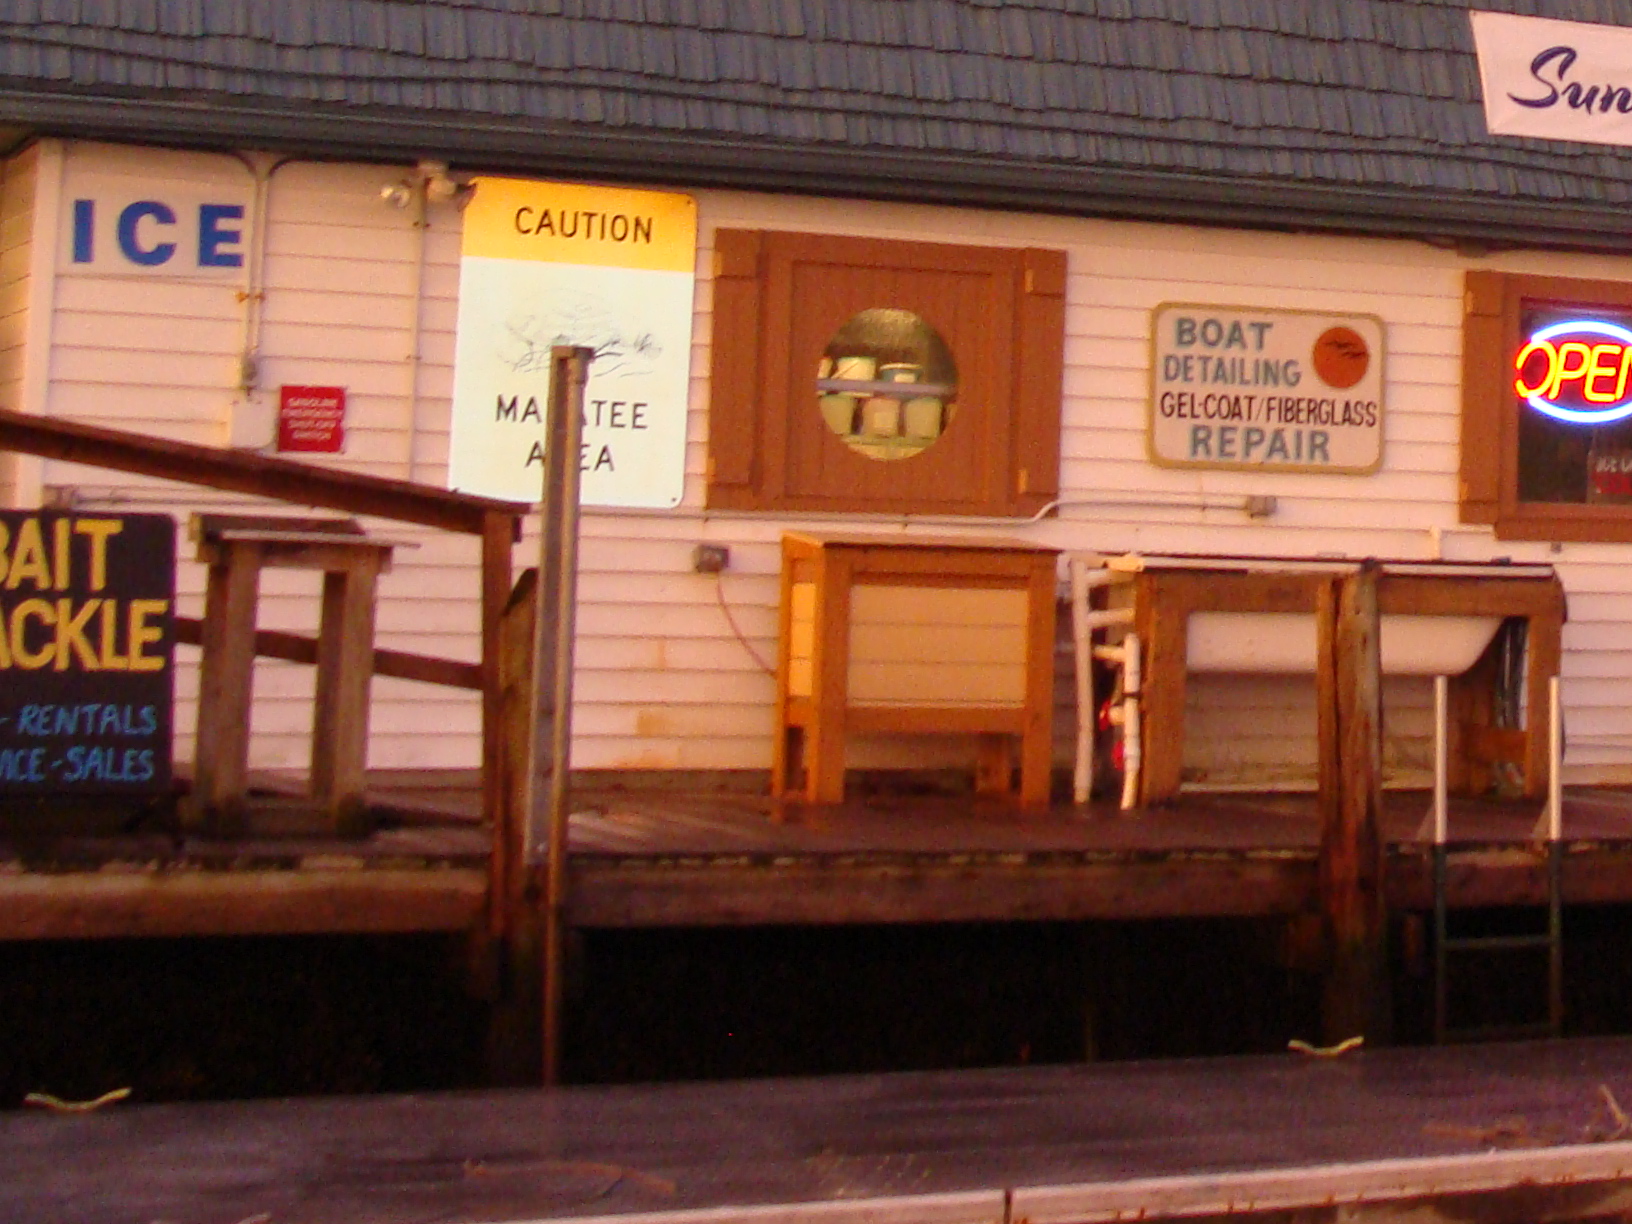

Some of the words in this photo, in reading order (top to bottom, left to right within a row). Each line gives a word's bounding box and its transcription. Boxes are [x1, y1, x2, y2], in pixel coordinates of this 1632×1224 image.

[73, 199, 245, 267] ICE
[513, 206, 653, 245] CAUTION
[1175, 317, 1274, 351] BOAT
[1162, 353, 1303, 388] DETAILING
[494, 393, 648, 431] MATEE
[524, 440, 615, 473] AEA
[1189, 423, 1331, 463] REPAIR
